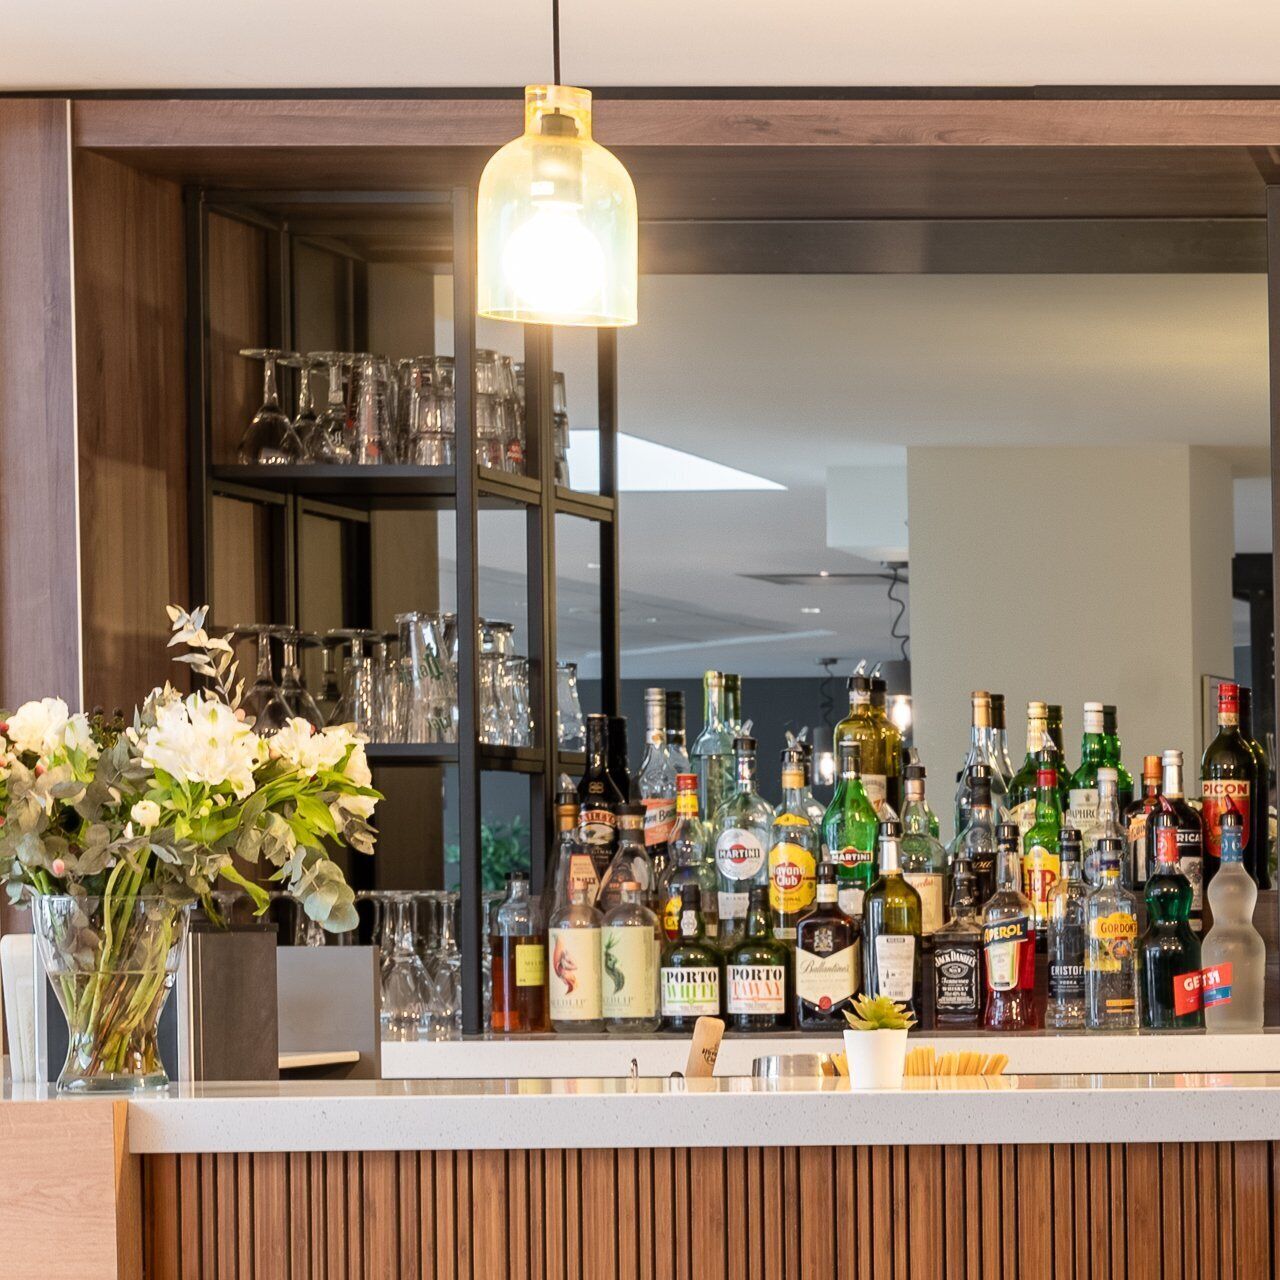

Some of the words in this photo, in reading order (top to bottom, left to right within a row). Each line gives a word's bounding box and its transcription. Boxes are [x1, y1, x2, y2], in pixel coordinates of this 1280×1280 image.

[1203, 783, 1249, 796] PICON
[1175, 832, 1201, 843] RICA
[719, 847, 760, 860] MARTINI
[831, 852, 870, 862] MARTINI
[776, 874, 798, 886] Club
[985, 923, 1023, 943] APEROL
[935, 953, 951, 968] JACK
[950, 950, 977, 968] DANIEL'S
[801, 959, 850, 974] Ballantine's
[666, 970, 717, 983] PORTO
[732, 968, 783, 981] PORTO
[667, 983, 716, 999] WHITE
[732, 981, 782, 997] TAWNY
